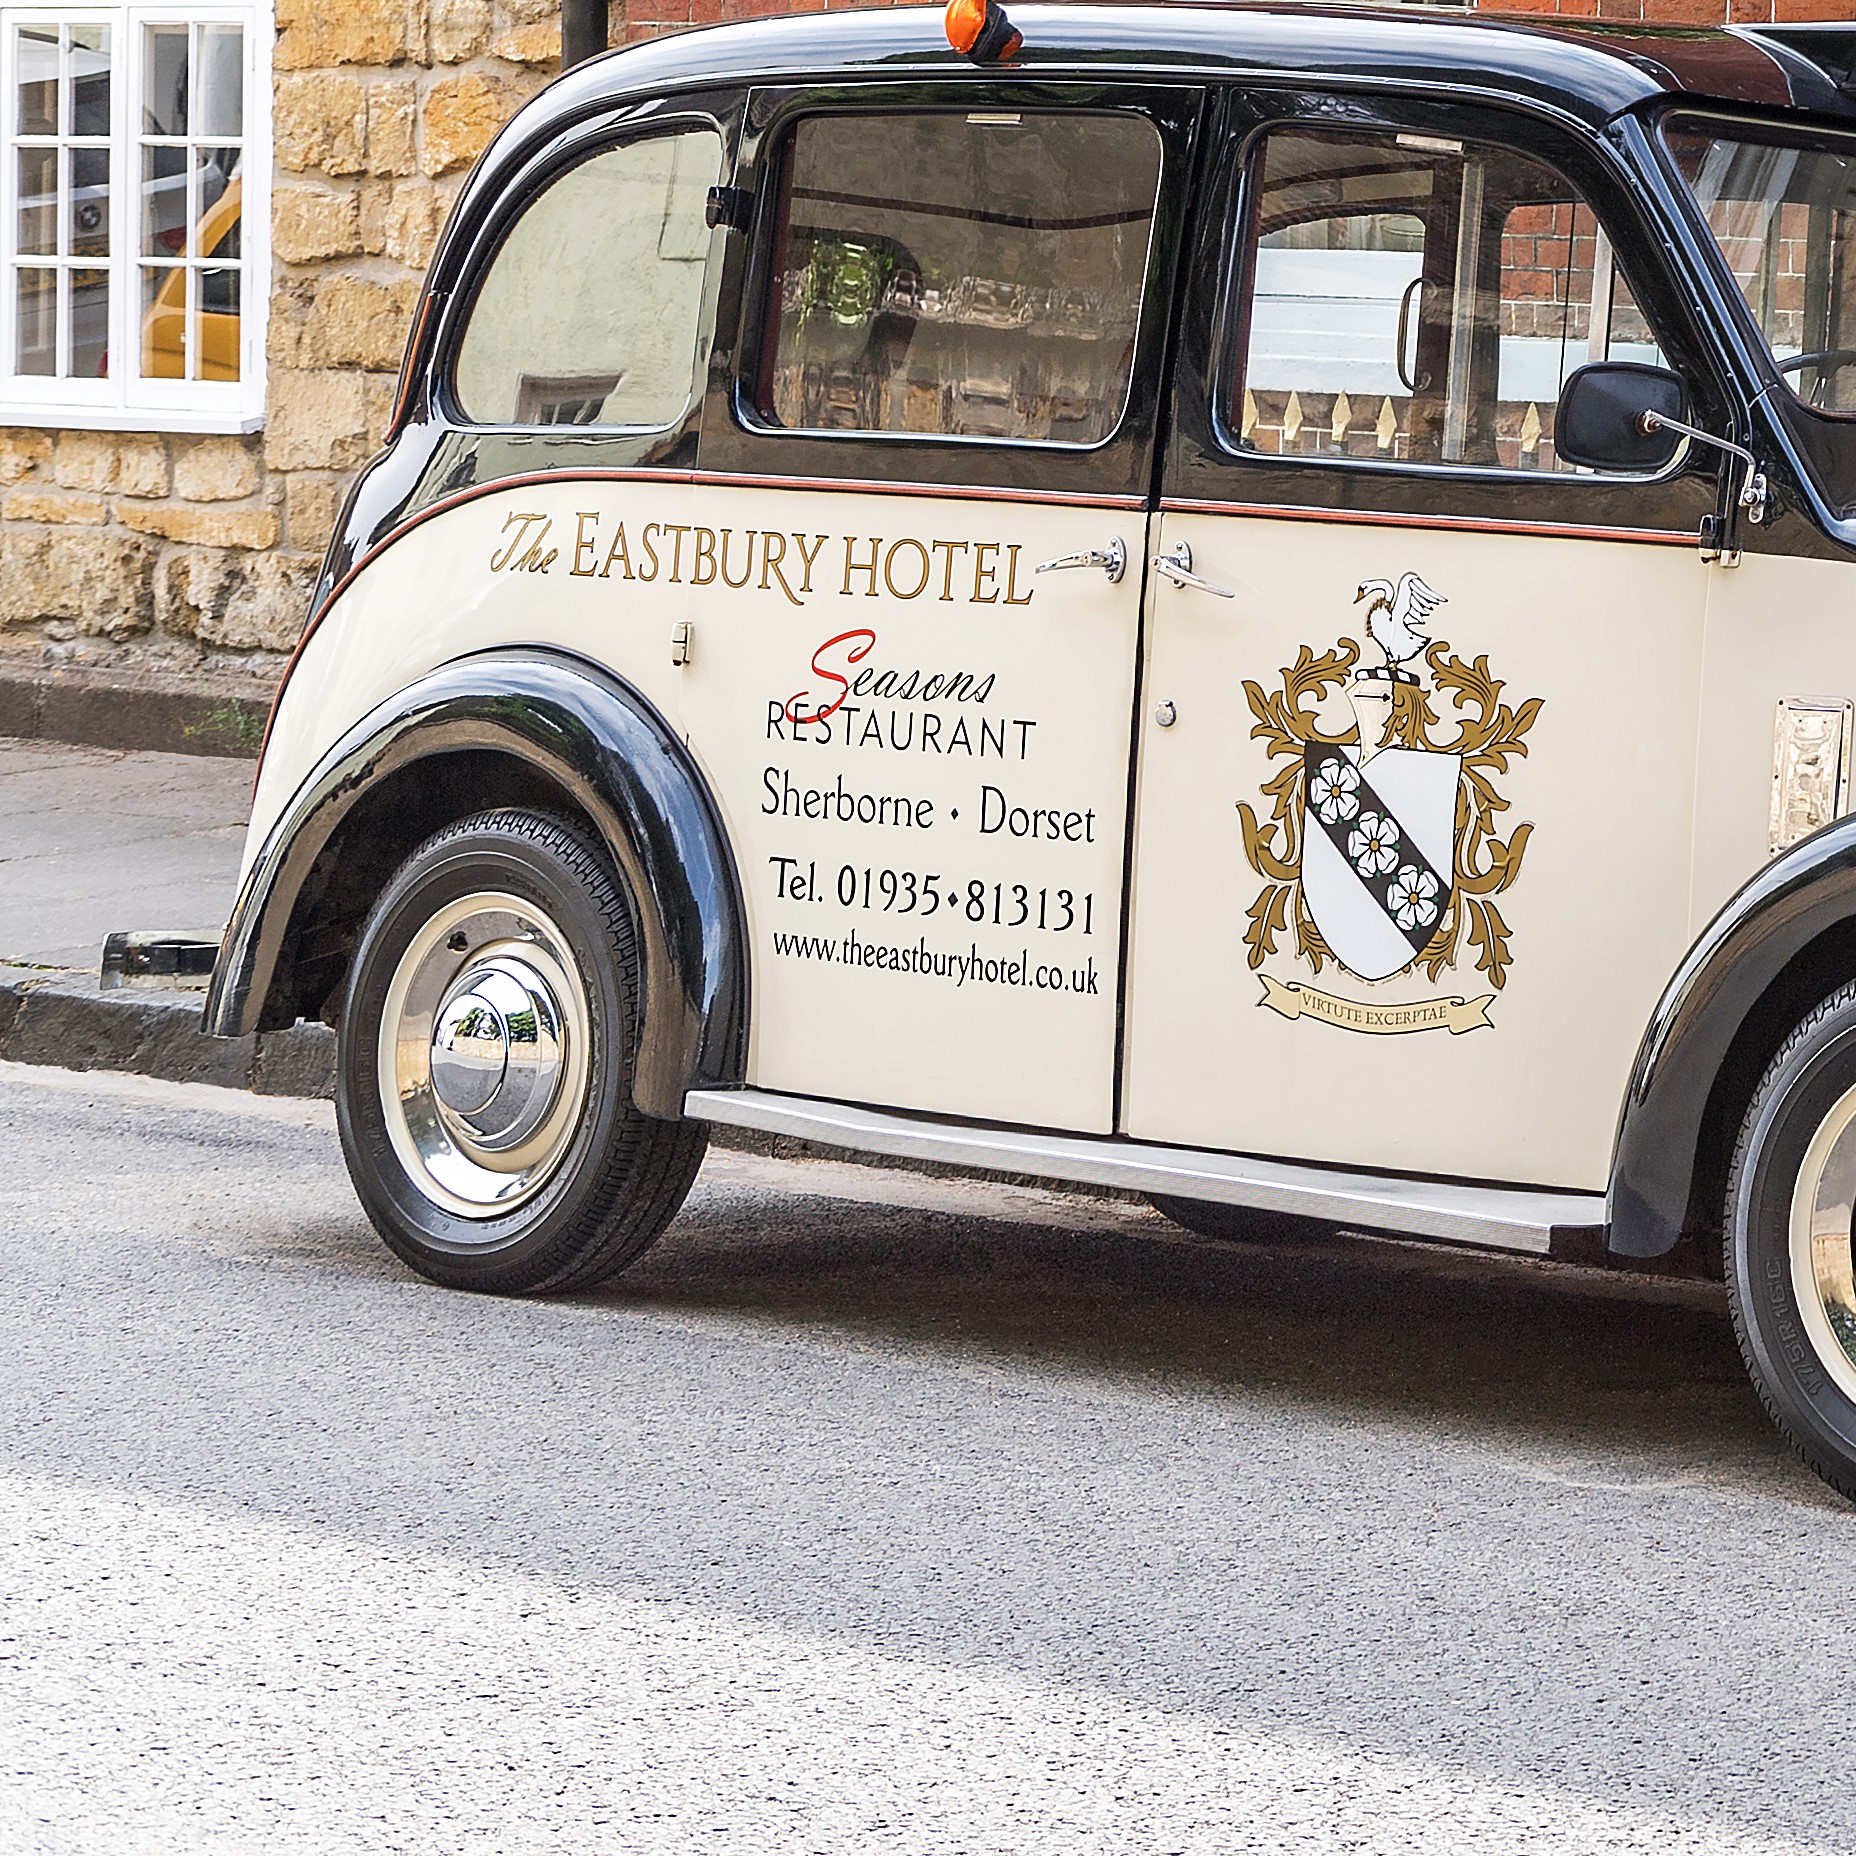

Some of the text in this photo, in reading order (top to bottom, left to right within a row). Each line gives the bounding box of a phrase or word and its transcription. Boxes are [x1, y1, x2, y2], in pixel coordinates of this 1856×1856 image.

[490, 510, 1035, 606] The EASTBURY HOTEL
[785, 628, 998, 724] Seasons
[766, 700, 1038, 760] RESTAURANT
[760, 766, 1096, 843] Sherborne Dorset
[769, 856, 825, 904] Tel.
[772, 931, 1100, 996] www.theeastburyhotel.co.uk
[1302, 992, 1447, 1026] VIRTUTE EXCERPTAE
